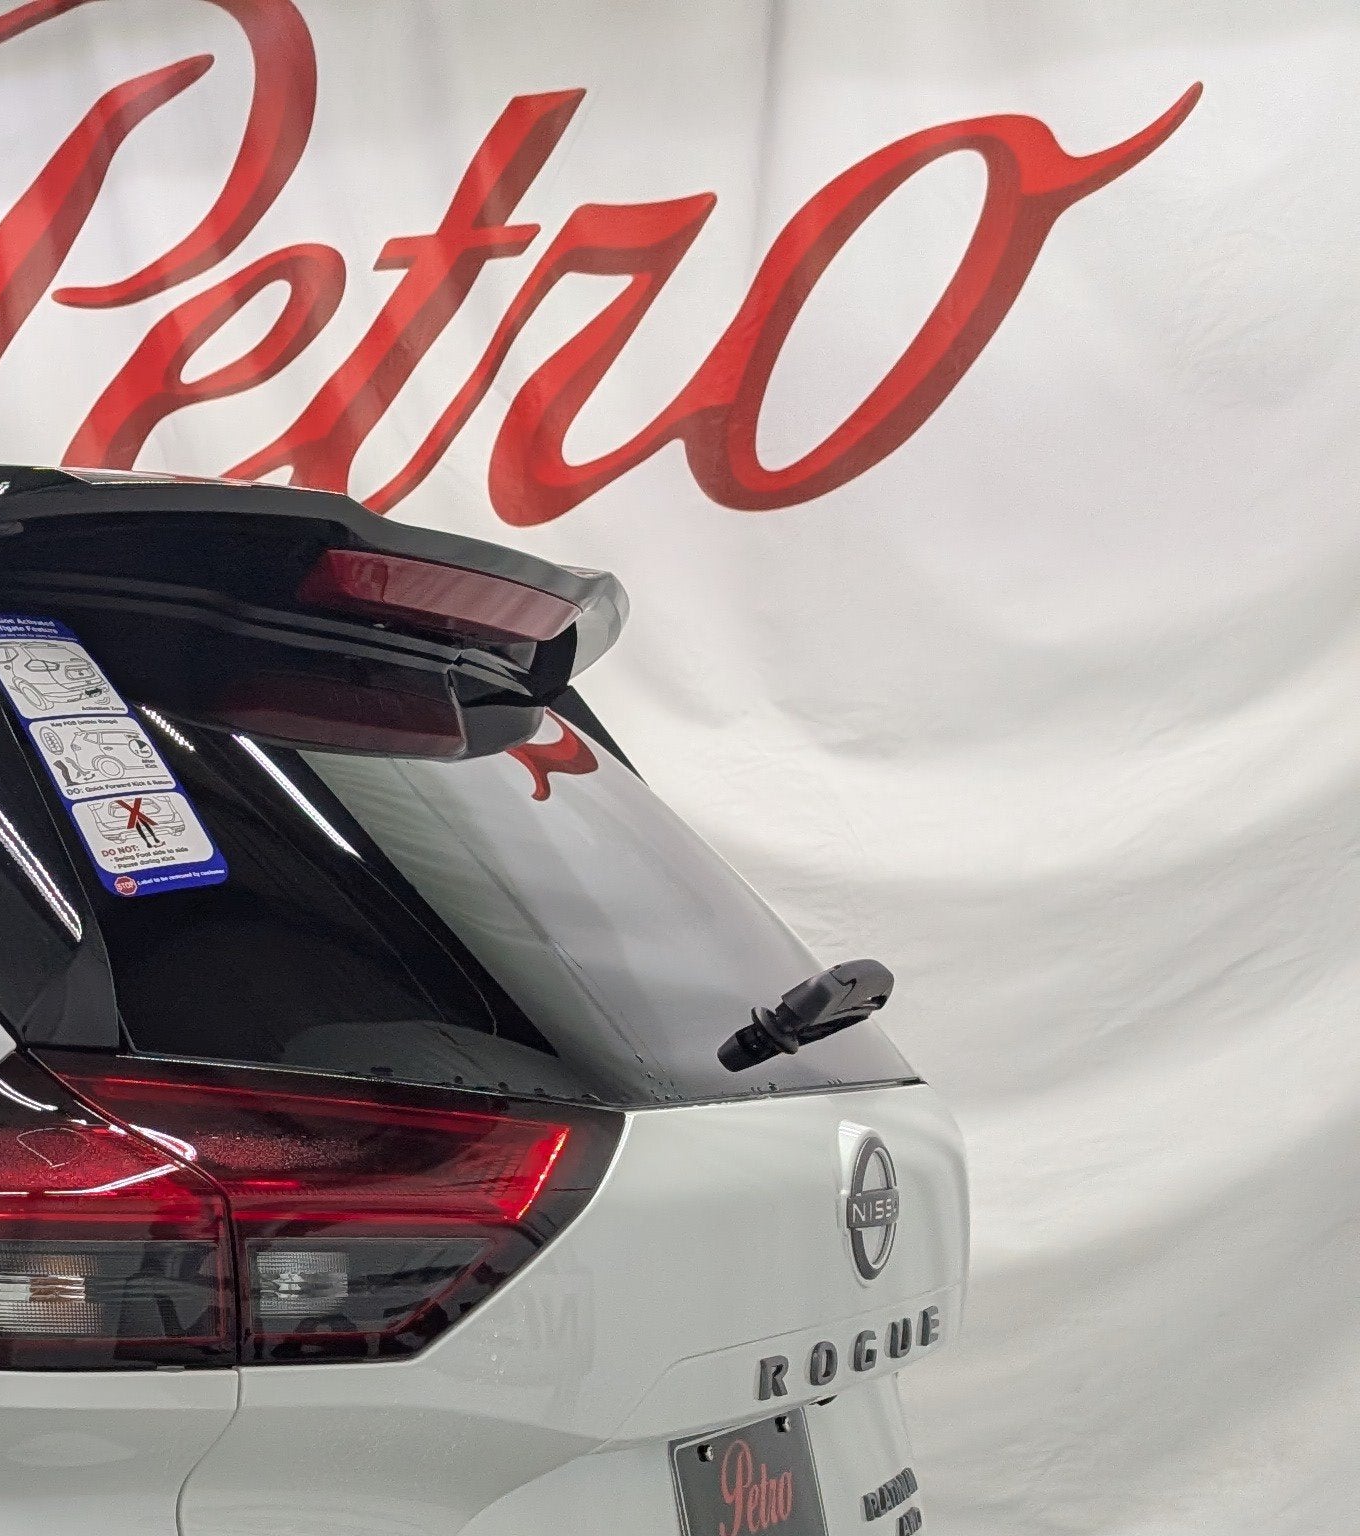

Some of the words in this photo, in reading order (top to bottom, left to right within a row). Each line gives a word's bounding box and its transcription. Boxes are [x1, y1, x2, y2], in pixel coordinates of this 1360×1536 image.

[101, 849, 116, 857] DO
[117, 845, 140, 854] NOT:
[852, 1199, 897, 1223] NISS
[758, 1305, 940, 1401] ROGUE
